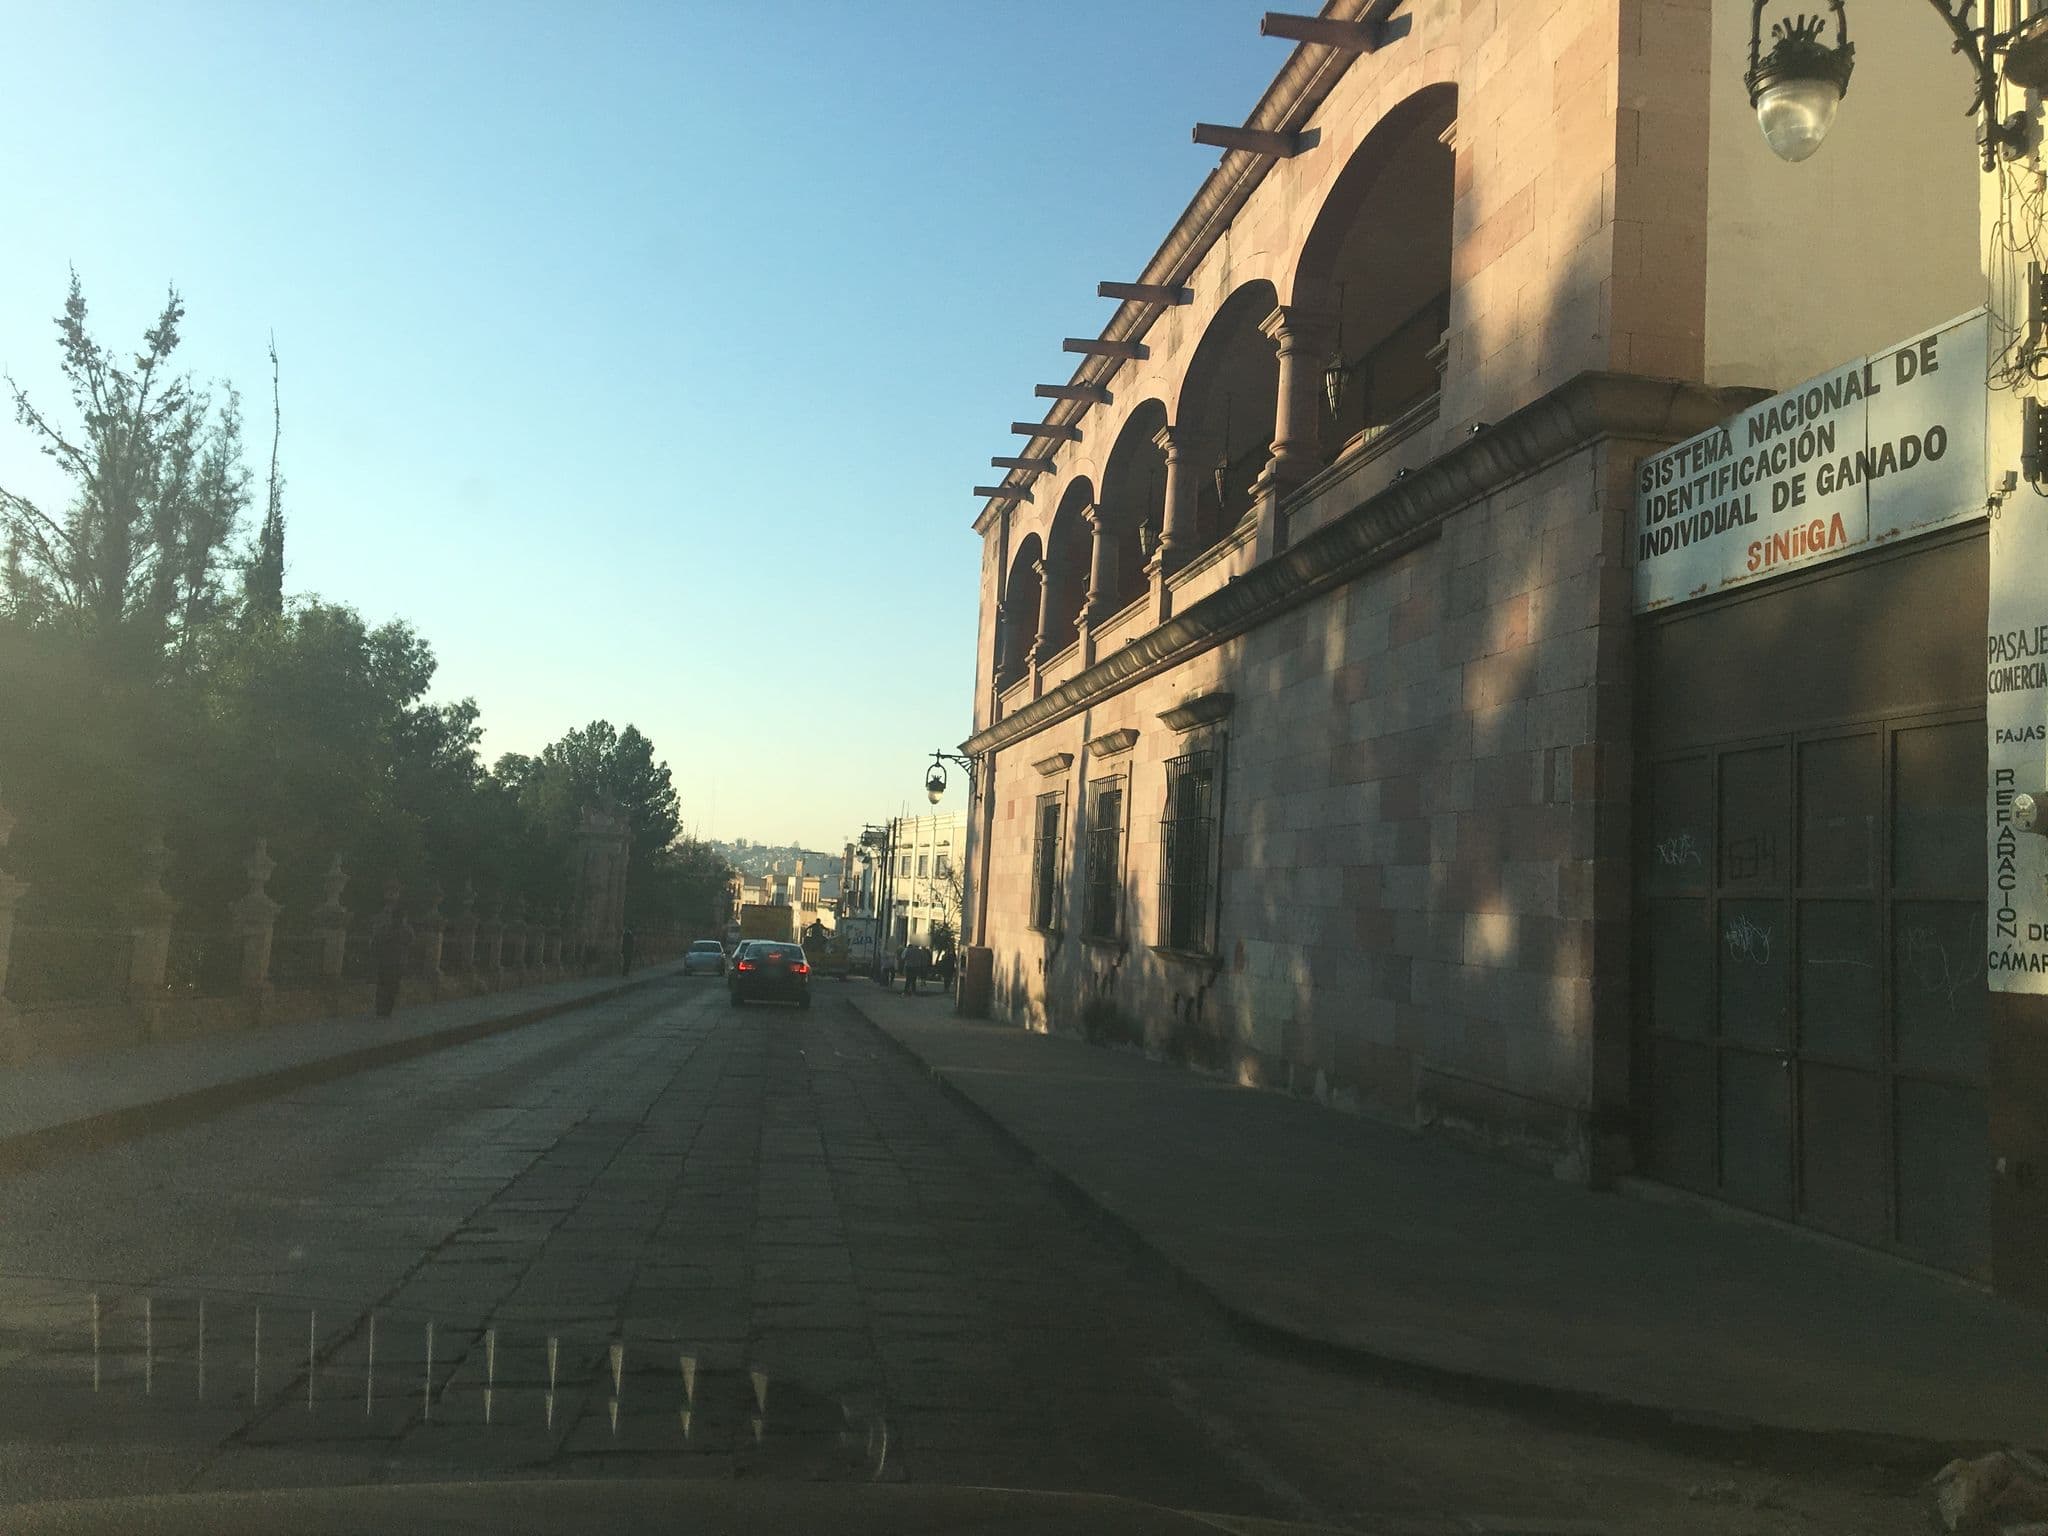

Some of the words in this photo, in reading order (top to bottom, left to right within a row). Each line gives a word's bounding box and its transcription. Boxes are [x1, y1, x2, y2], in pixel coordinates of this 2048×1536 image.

[1641, 429, 1733, 493] SISTEMA
[1748, 363, 1880, 447] NACIONAL
[1896, 336, 1938, 386] DE
[1639, 494, 1758, 561] INDIVIDUAL
[1772, 473, 1806, 514] DE
[1816, 425, 1947, 496] GANADO
[1646, 421, 1836, 526] IDENTIFICACIÓN
[1989, 624, 2048, 664] PASAJE
[1996, 725, 2045, 744] FAJAS
